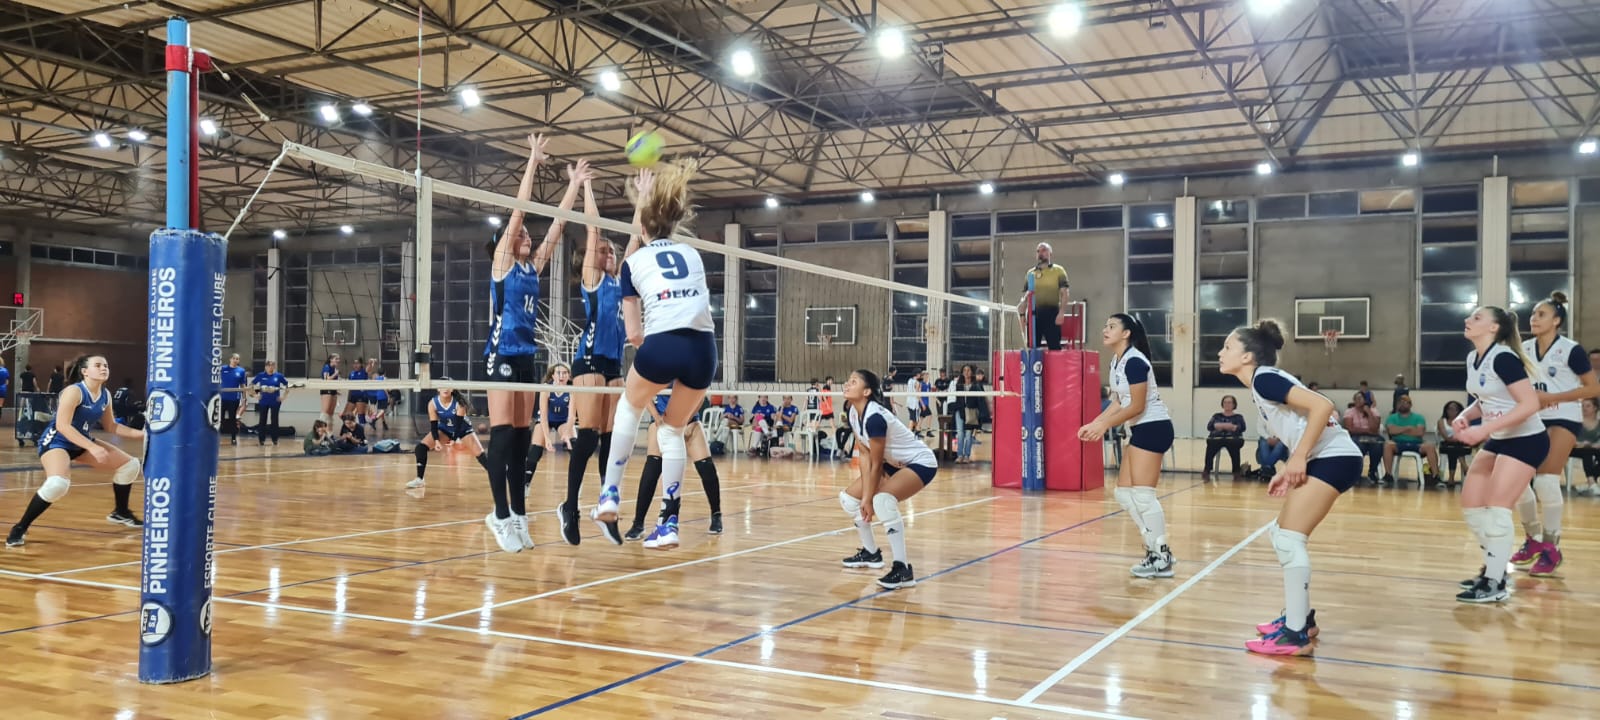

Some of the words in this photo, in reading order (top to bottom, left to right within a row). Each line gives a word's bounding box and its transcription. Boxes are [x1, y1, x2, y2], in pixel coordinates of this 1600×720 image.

[655, 250, 689, 280] 9
[213, 271, 226, 317] CLUBE
[524, 294, 534, 314] 14
[156, 267, 176, 382] PINHEIROS
[211, 319, 222, 384] ESPORTE
[82, 421, 89, 432] 4
[149, 476, 171, 594] PINHEIROS
